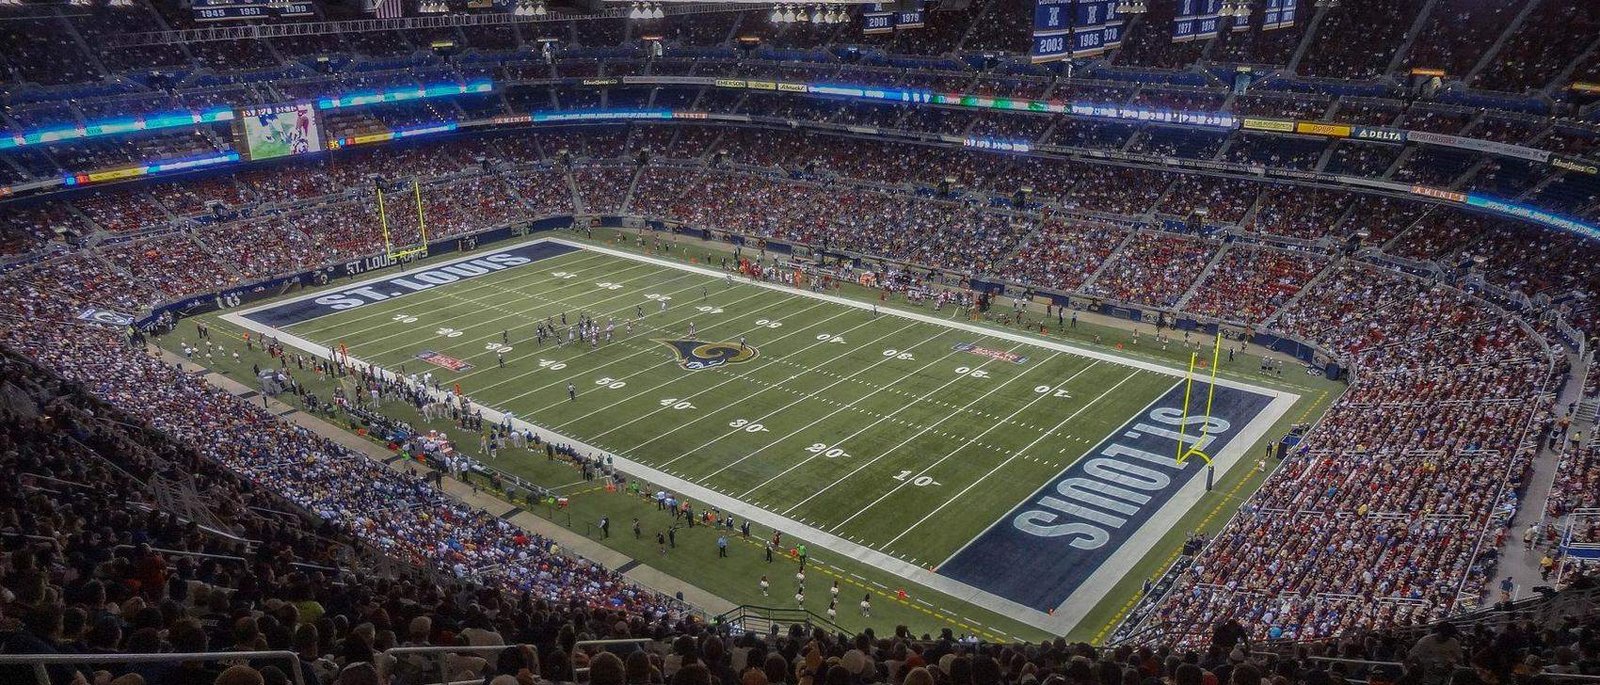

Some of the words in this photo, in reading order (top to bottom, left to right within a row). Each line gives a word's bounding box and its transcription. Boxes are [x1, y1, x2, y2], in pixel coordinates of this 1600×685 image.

[201, 10, 225, 18] 1945
[902, 13, 920, 22] 1979
[869, 18, 888, 27] 2001
[1080, 33, 1099, 47] 1985
[1104, 28, 1118, 41] 978
[1040, 37, 1063, 52] 2003
[1369, 131, 1401, 140] DELTA
[346, 260, 364, 275] ST.
[366, 254, 397, 271] LOUIS
[315, 286, 402, 309] ST.
[390, 253, 531, 291] LOUIS
[595, 377, 626, 389] 50
[660, 398, 690, 410] 40
[729, 418, 763, 433] 30
[1124, 407, 1231, 451] ST.
[805, 443, 844, 458] 20
[893, 470, 933, 486] 10
[1013, 443, 1189, 550] LOUIS
